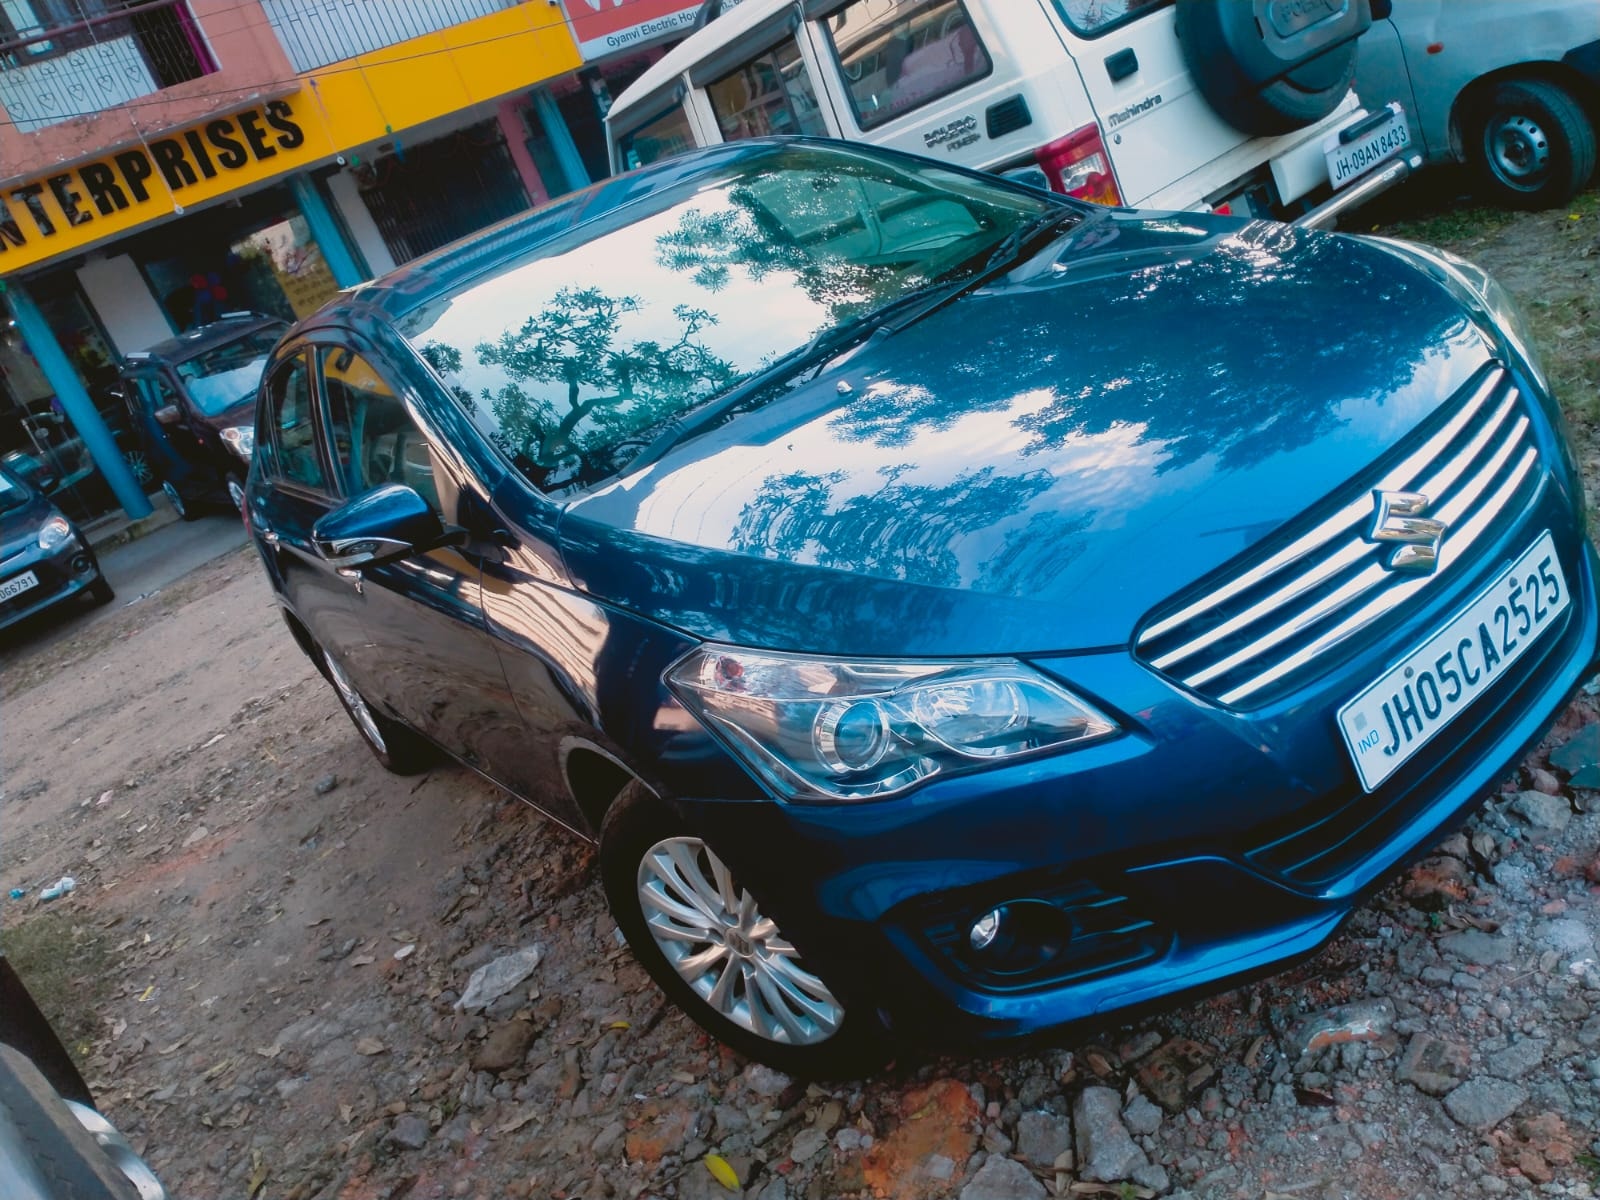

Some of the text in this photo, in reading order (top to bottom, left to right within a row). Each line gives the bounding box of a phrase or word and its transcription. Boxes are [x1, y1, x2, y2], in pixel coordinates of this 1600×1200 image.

[607, 10, 698, 47] Gyanvi Electric Hou
[1381, 125, 1407, 153] 8433
[1381, 556, 1561, 757] JH05CA2525
[1358, 729, 1380, 754] IND
